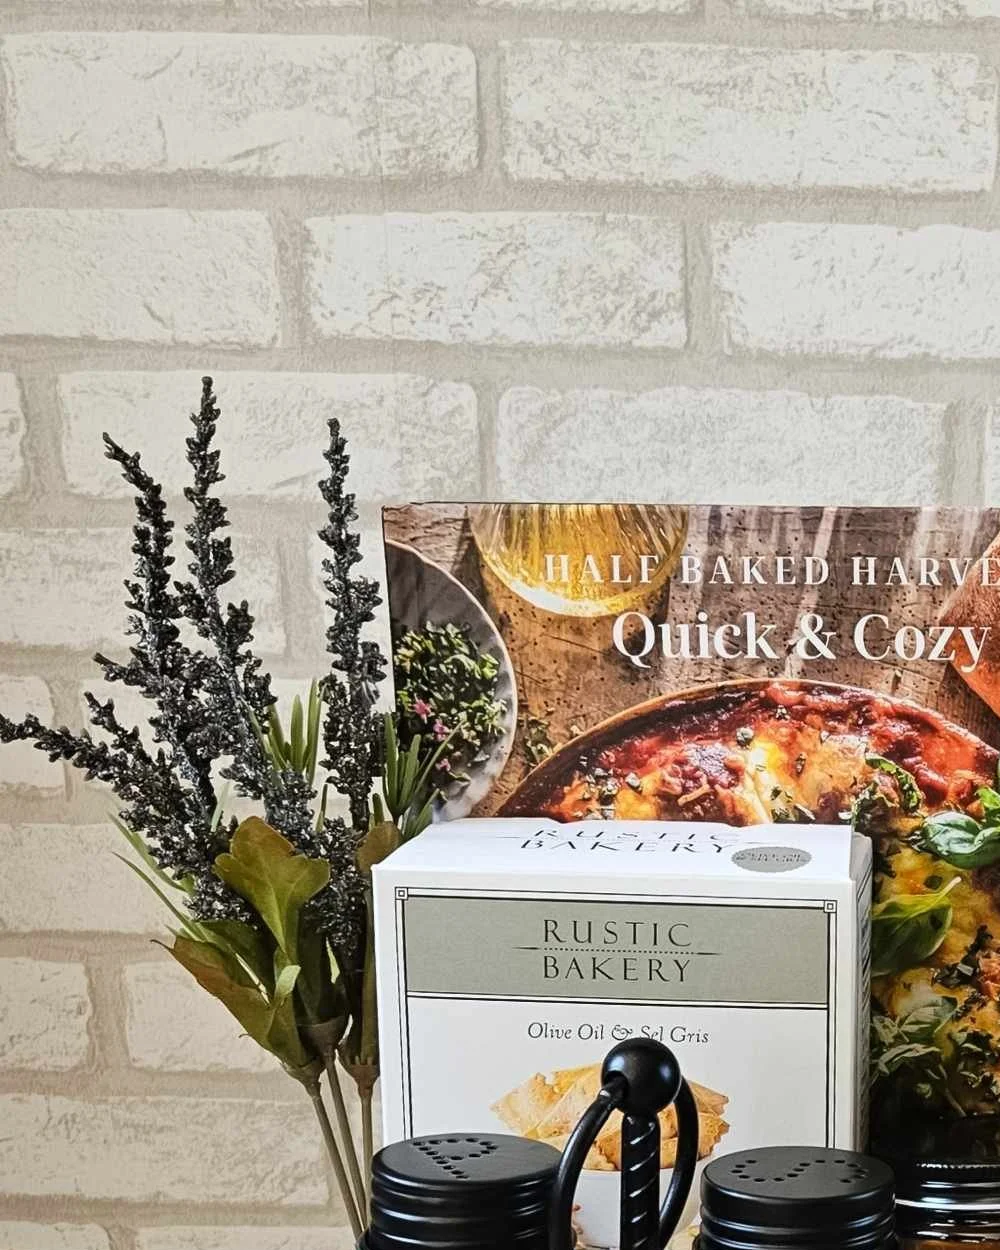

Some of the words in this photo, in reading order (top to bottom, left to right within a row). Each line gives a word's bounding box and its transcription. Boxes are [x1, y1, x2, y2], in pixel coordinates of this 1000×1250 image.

[544, 553, 660, 584] HALF
[680, 554, 830, 586] BAKED
[612, 611, 781, 670] Quick
[796, 612, 837, 661] &
[853, 613, 992, 674] Cozy
[520, 840, 735, 854] BAKERY
[533, 829, 742, 841] RUSTIC
[543, 919, 692, 948] RUSTIC
[543, 954, 692, 983] BAKERY
[527, 1022, 572, 1040] Olive
[577, 1023, 605, 1041] Oil
[611, 1024, 633, 1041] &
[639, 1024, 664, 1042] Sel
[669, 1025, 710, 1044] Gris
